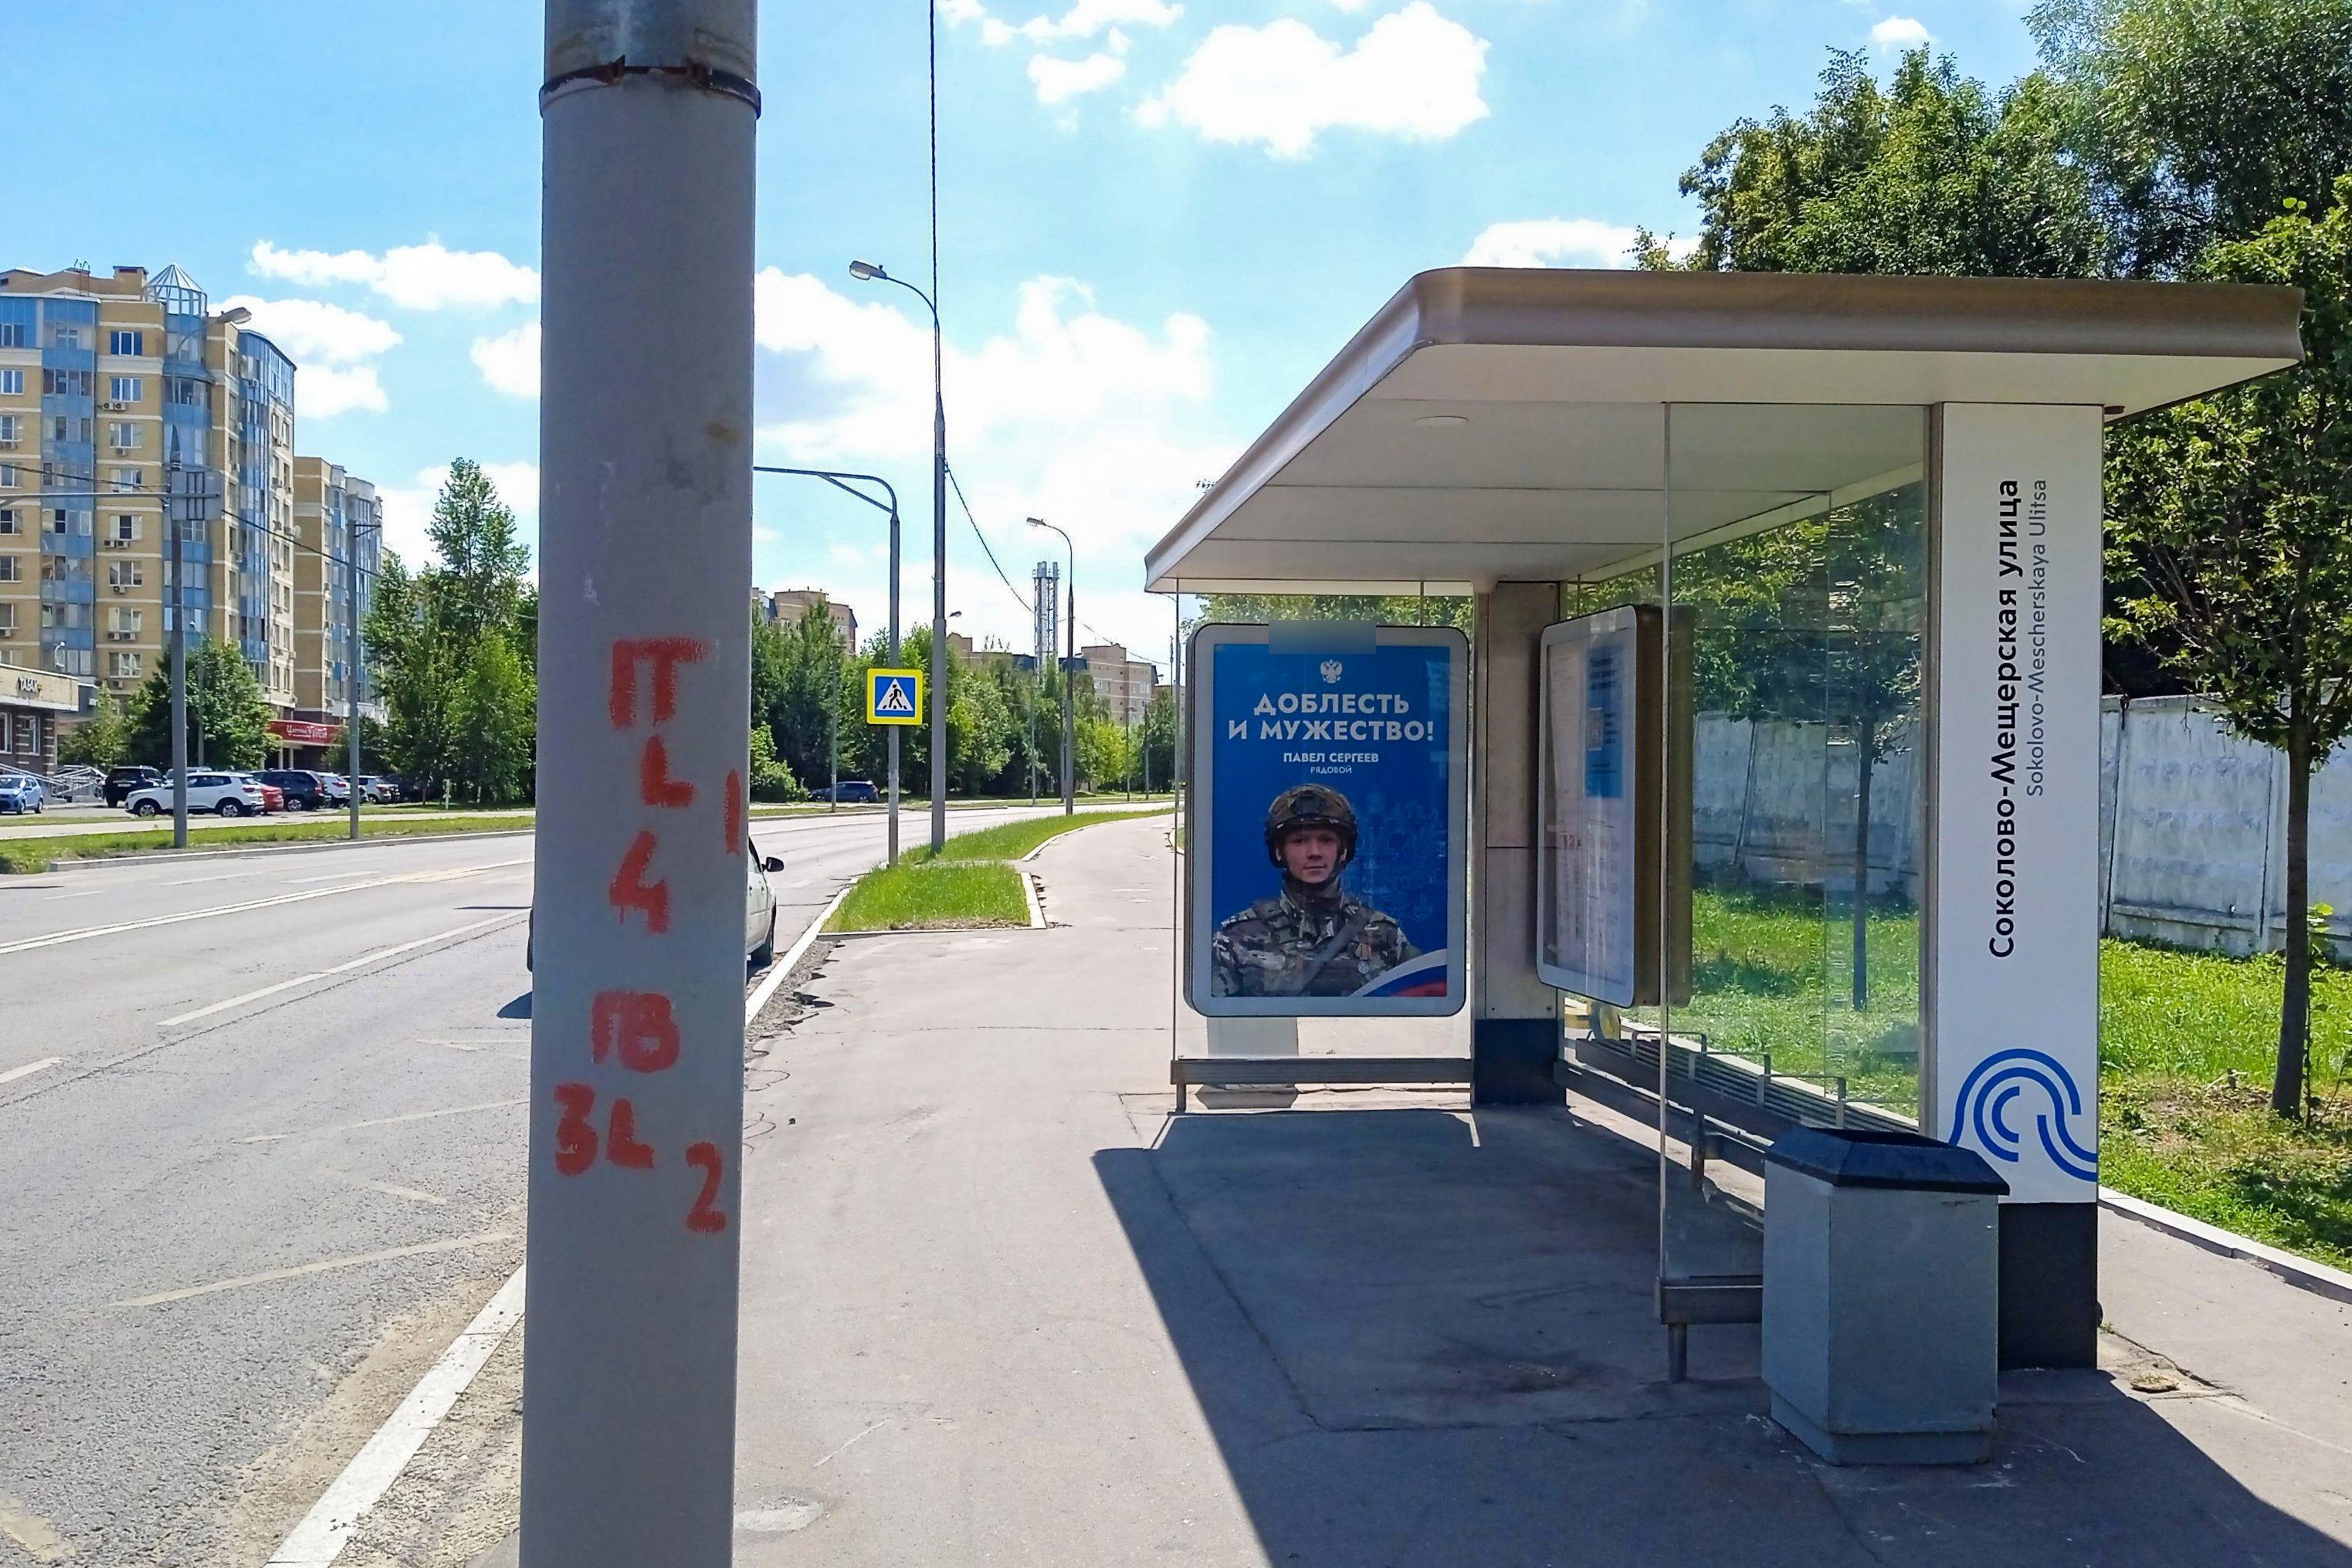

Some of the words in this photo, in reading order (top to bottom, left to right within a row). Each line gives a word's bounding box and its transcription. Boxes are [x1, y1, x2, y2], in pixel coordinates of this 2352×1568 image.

[2028, 480, 2046, 536] Ulitsa
[1998, 480, 2023, 577] улица
[2026, 544, 2049, 796] Sokolovo-Mescherskaya
[1254, 693, 1410, 716] ДОБЛЕСТЬ
[1229, 720, 1247, 740] И
[1260, 720, 1434, 741] МУЖЕСТВО!
[1283, 752, 1325, 763] ПАВЕЛ
[1329, 752, 1379, 763] СЕРГЕЕВ
[1310, 765, 1352, 774] РЯДОВОЙ
[1989, 589, 2022, 958] Соколово-Мещерская
